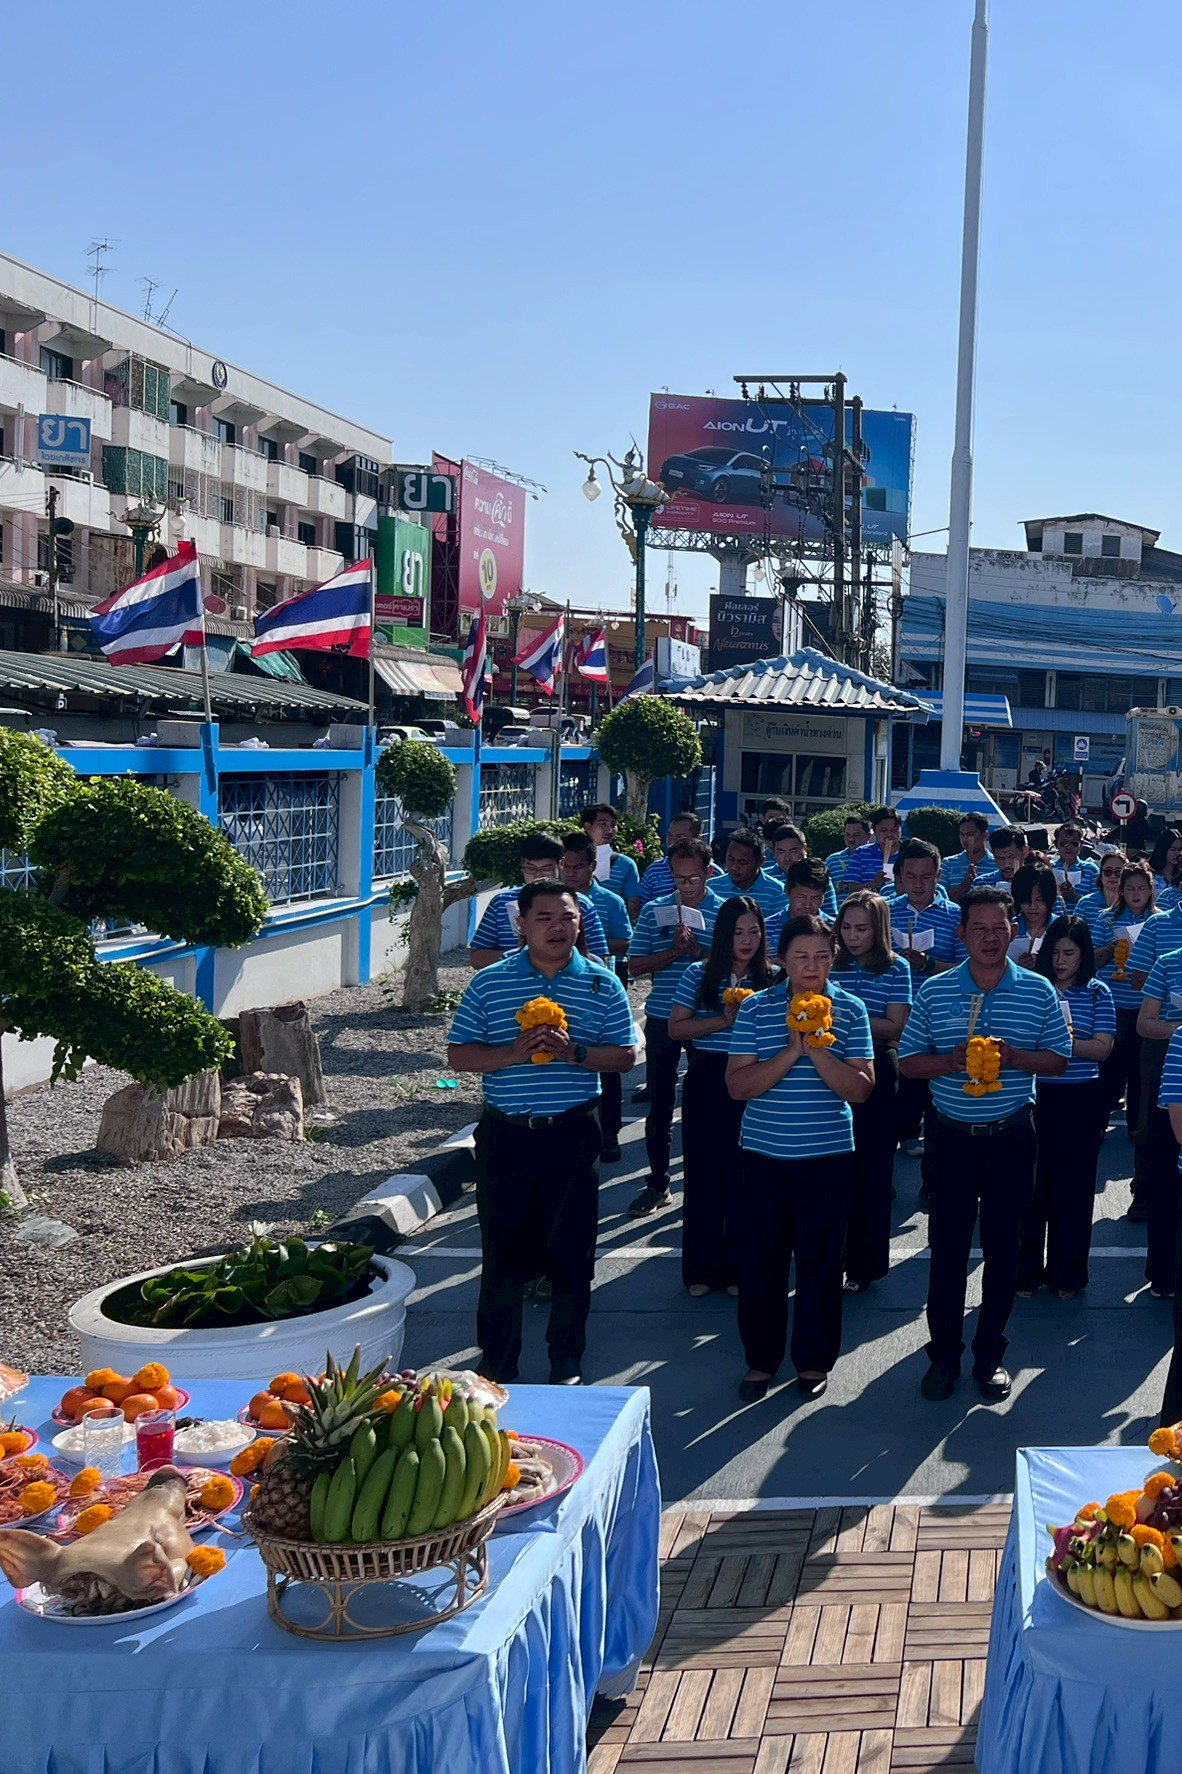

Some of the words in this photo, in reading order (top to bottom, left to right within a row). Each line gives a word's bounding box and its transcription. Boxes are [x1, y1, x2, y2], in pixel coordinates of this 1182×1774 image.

[668, 403, 690, 411] GAC
[41, 418, 88, 450] ยา
[703, 421, 745, 433] AION
[745, 417, 788, 435] UT
[403, 473, 452, 511] ยา
[728, 518, 757, 526] Premium
[402, 550, 424, 597] ยา
[482, 558, 494, 583] 10
[717, 610, 767, 625] นิวรามิส
[712, 637, 769, 651] Neuramis
